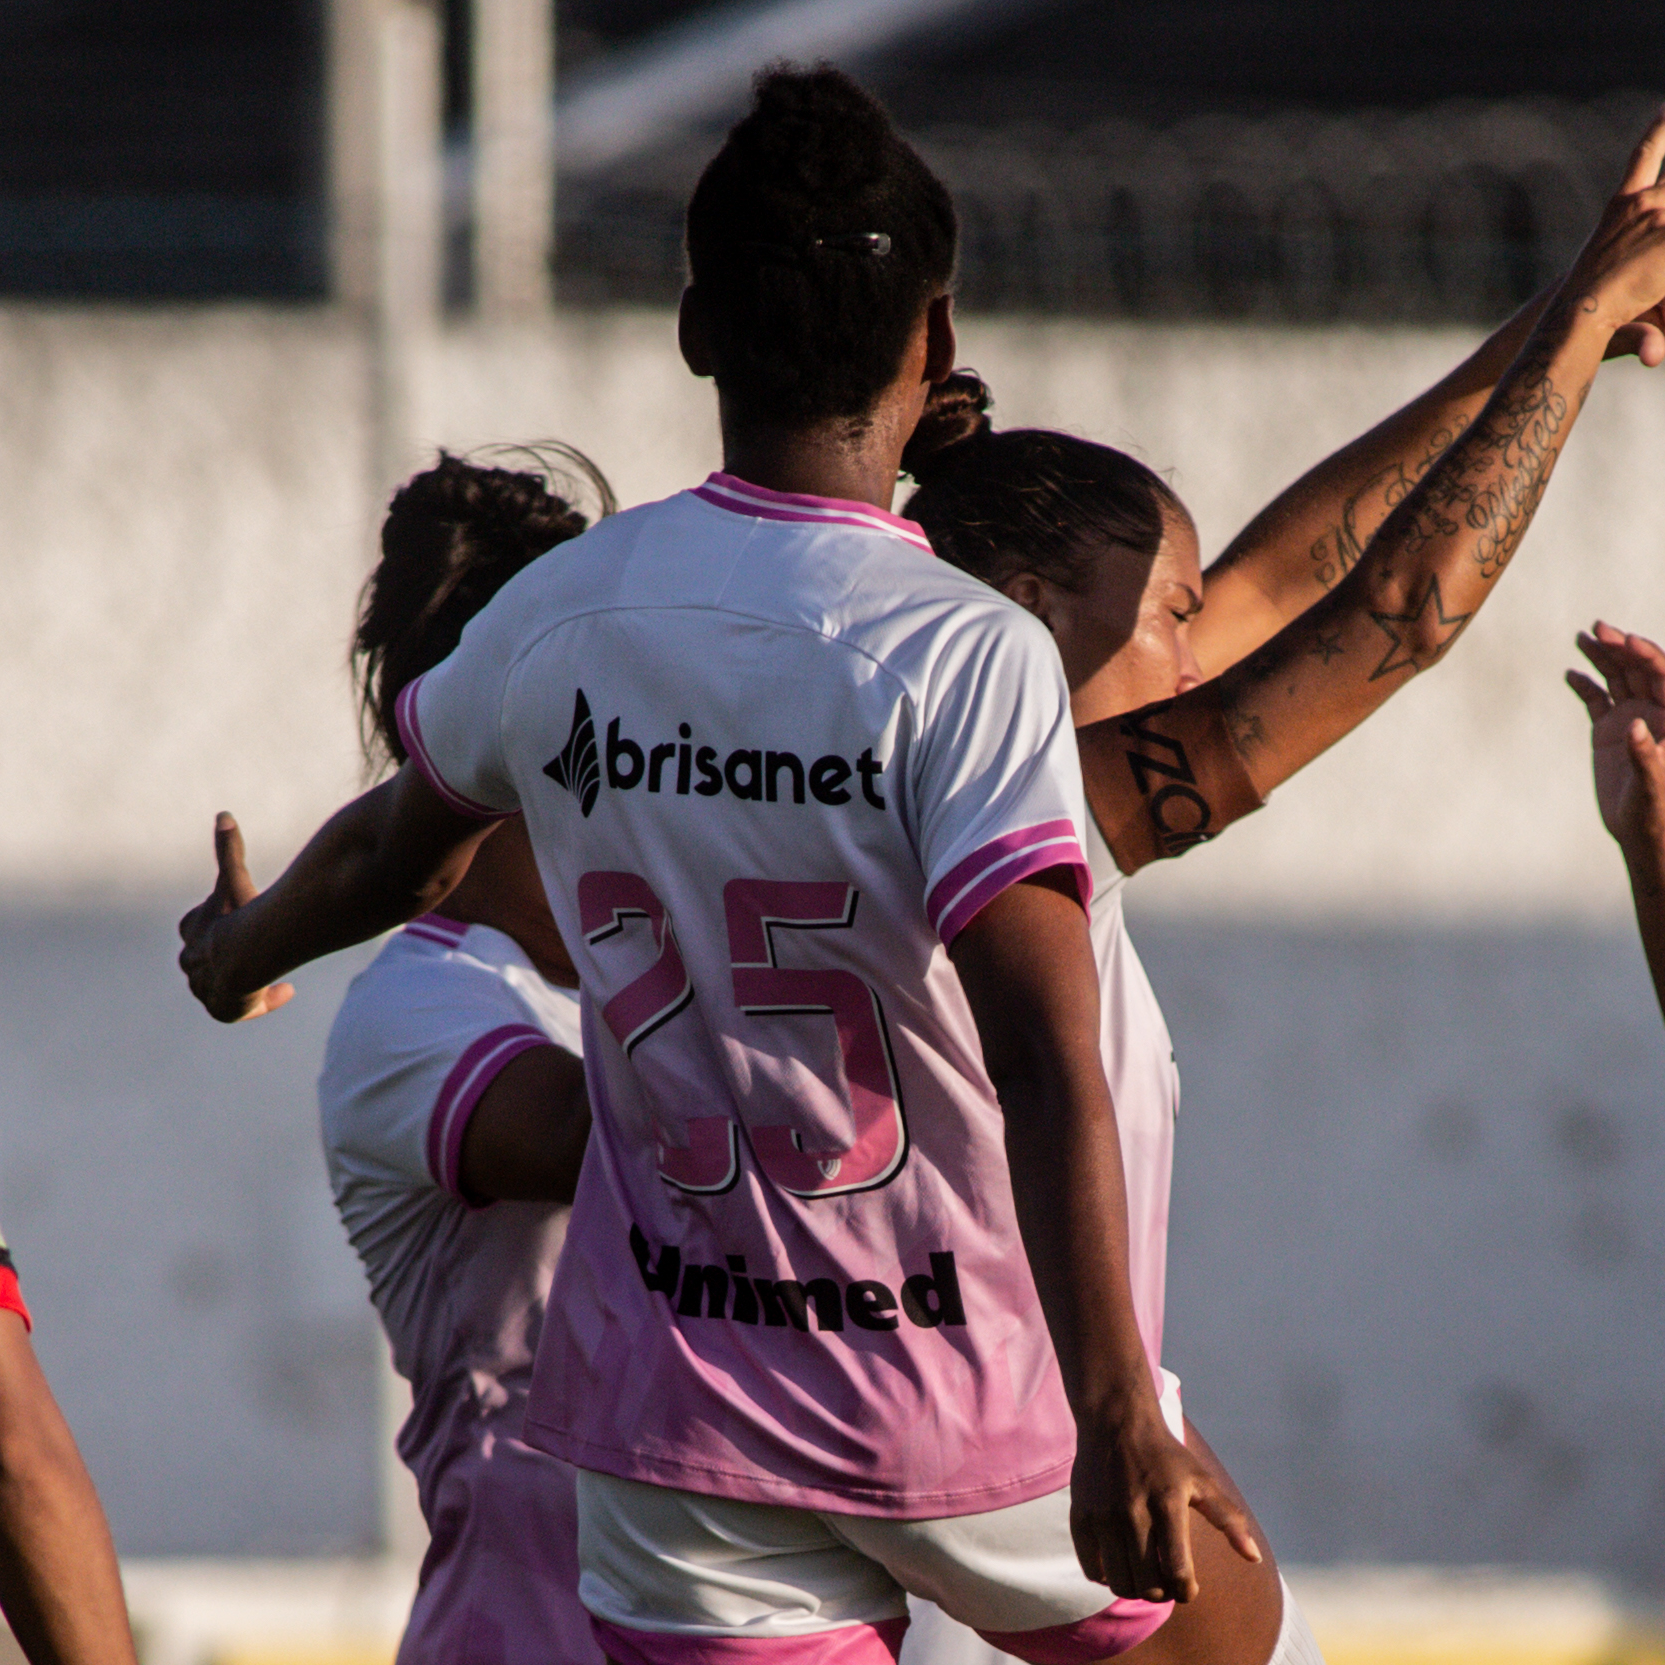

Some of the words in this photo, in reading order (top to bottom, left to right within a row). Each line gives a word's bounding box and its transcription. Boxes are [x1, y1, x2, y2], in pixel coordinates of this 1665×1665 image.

[605, 716, 886, 811] brisanet
[577, 870, 911, 1200] 25
[629, 1221, 967, 1333] Unimed
